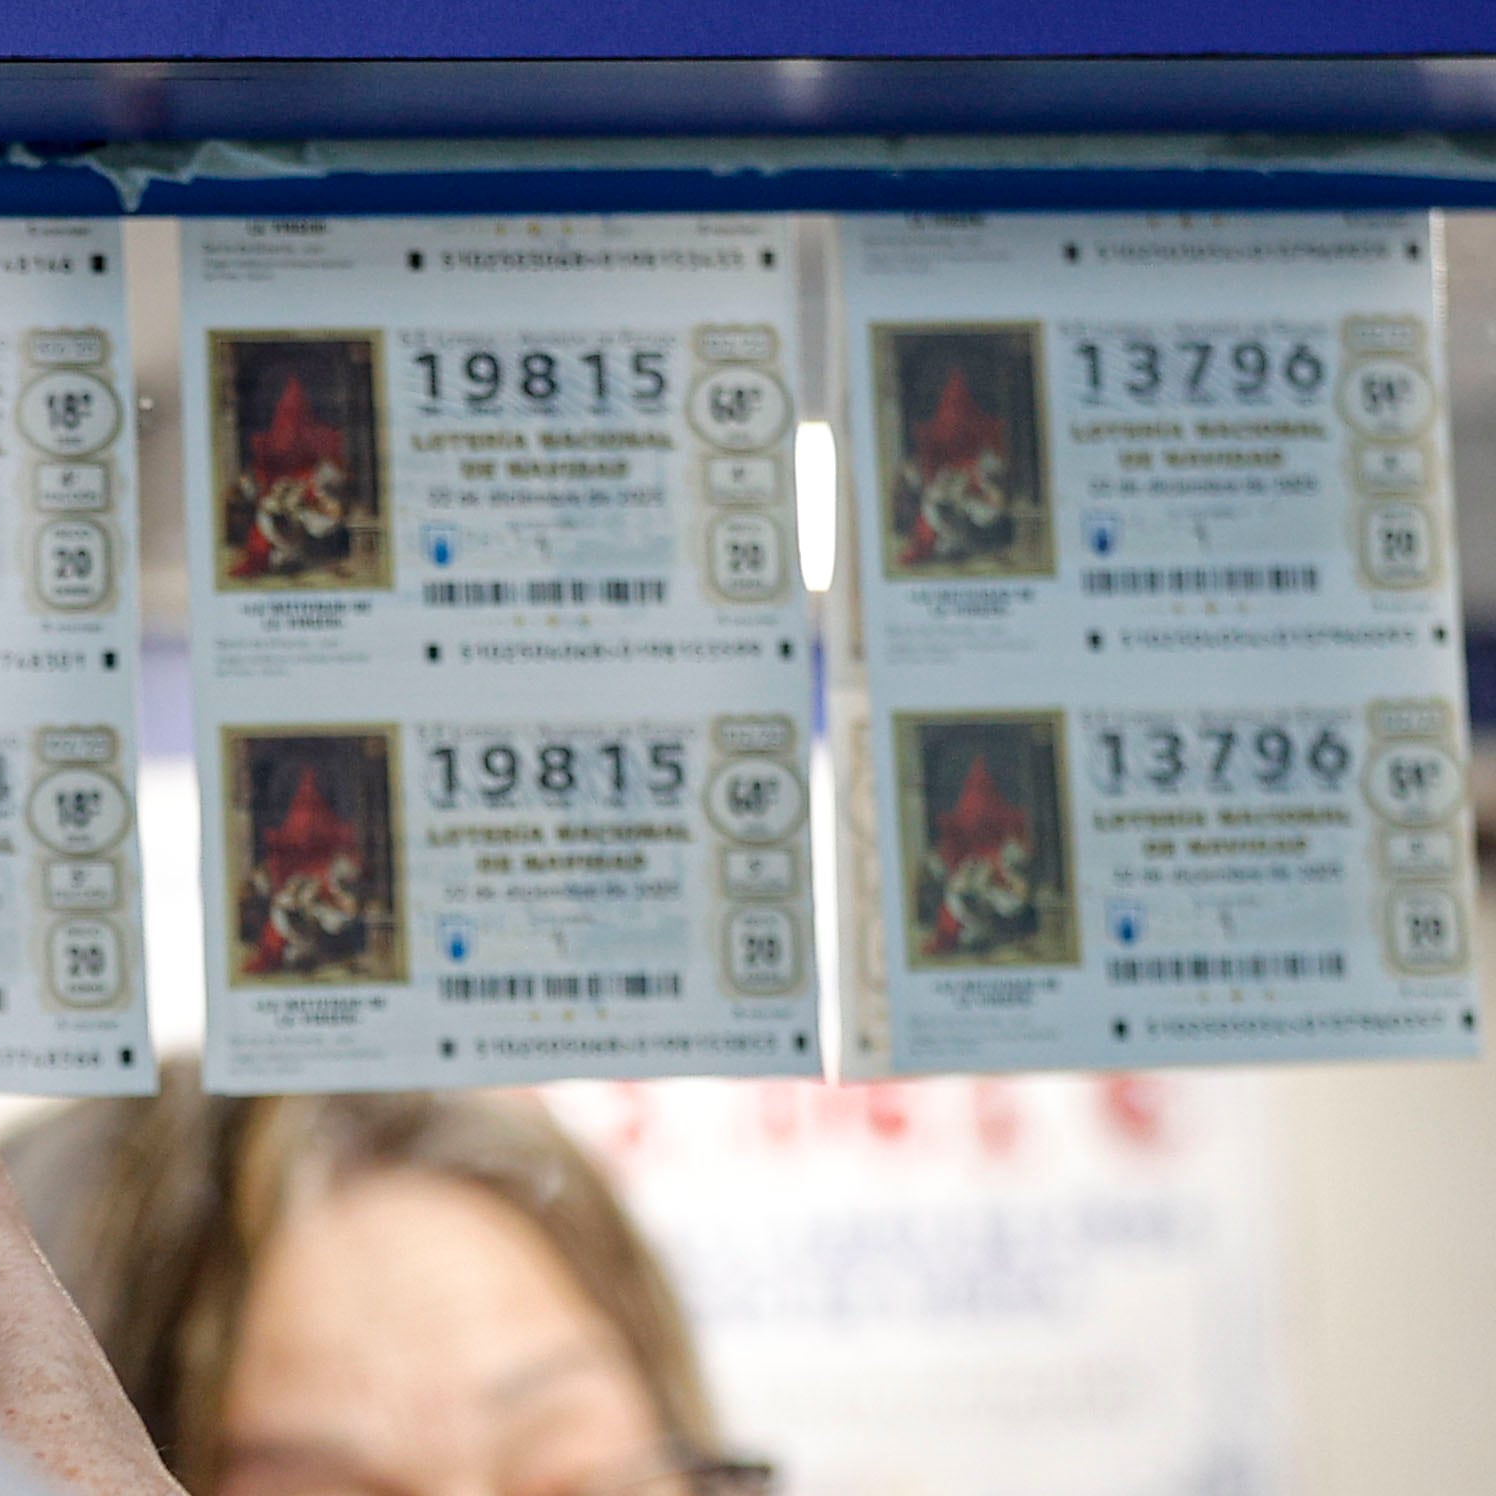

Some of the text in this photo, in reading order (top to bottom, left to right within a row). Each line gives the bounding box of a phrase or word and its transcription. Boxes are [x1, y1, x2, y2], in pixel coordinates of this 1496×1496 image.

[411, 348, 671, 400] 19815
[1074, 342, 1325, 394] 13796
[426, 744, 687, 796] 19815
[1092, 730, 1344, 780] 13796
